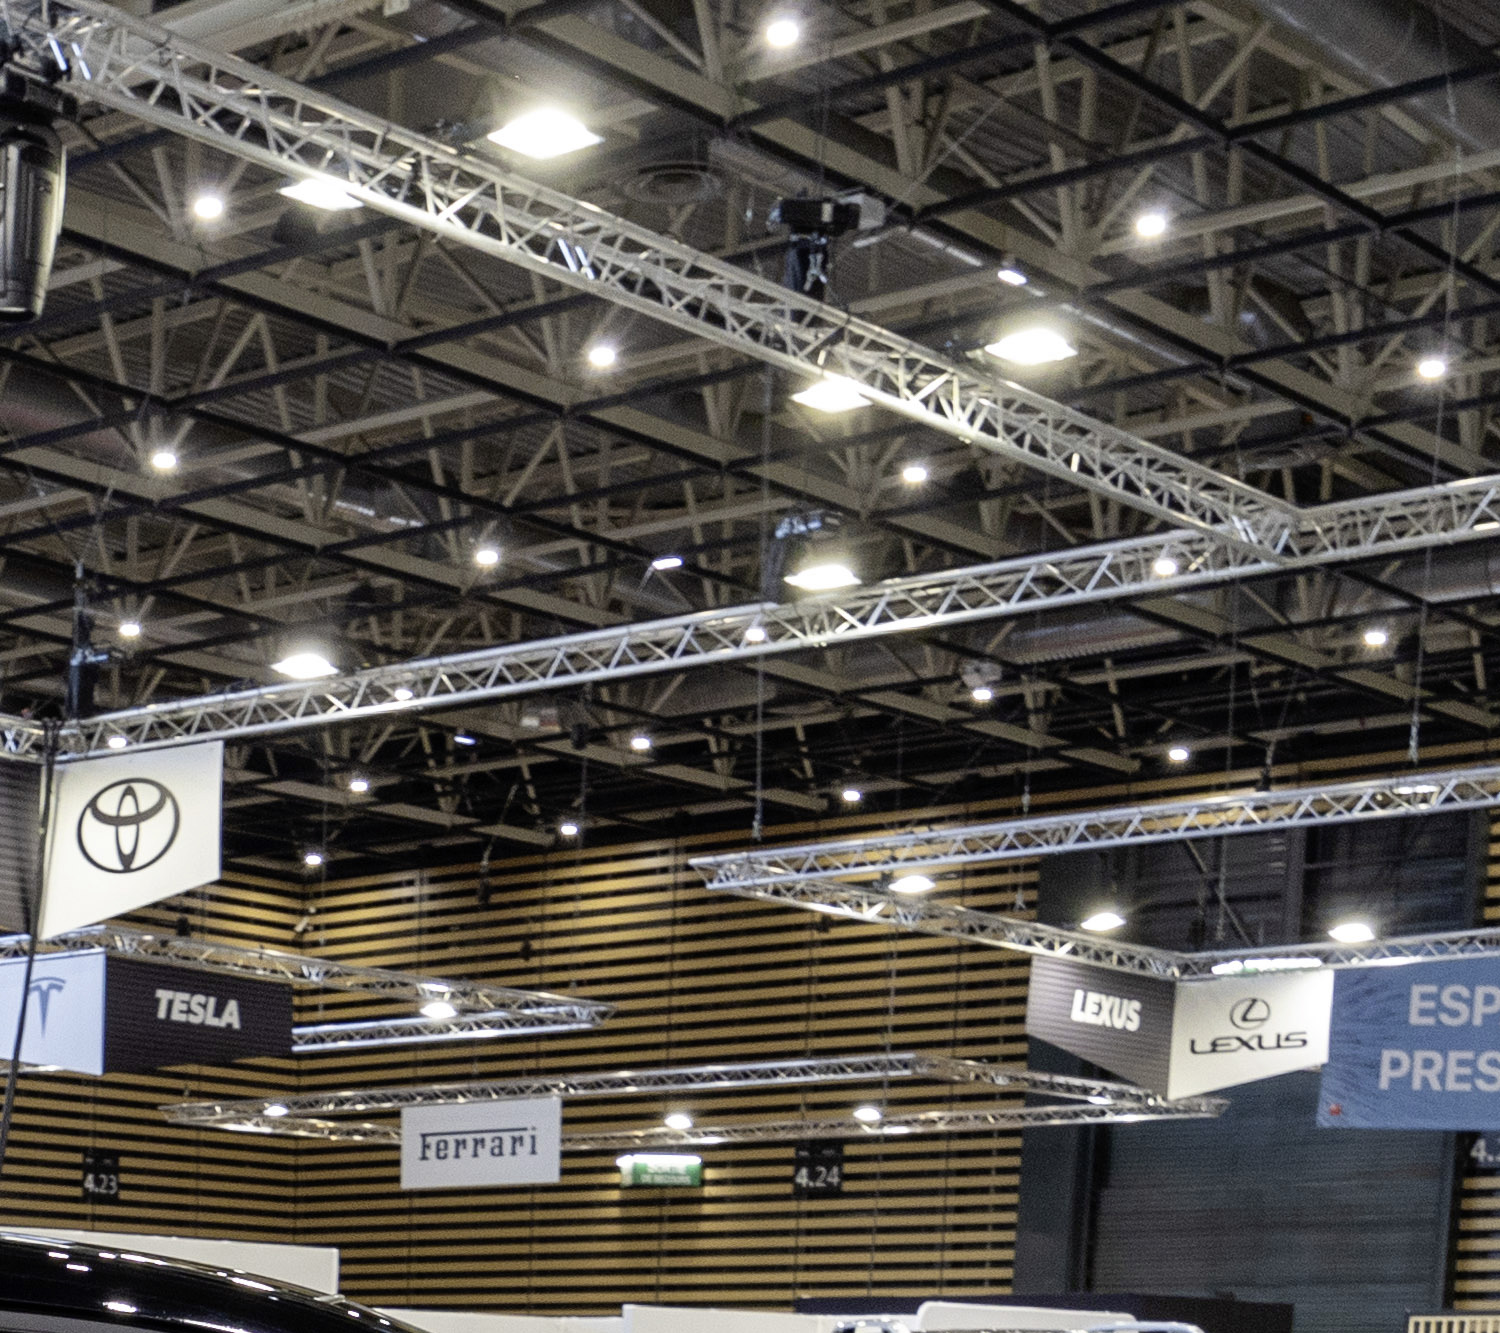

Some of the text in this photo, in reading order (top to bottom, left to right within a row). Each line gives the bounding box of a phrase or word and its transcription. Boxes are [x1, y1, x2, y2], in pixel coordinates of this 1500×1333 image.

[154, 988, 242, 1030] TESLA
[1070, 988, 1142, 1032] LEXUS
[1189, 1031, 1309, 1055] LEXUS
[419, 1125, 539, 1162] Ferrari
[83, 1172, 118, 1195] 4.23
[794, 1165, 841, 1187] 4.24
